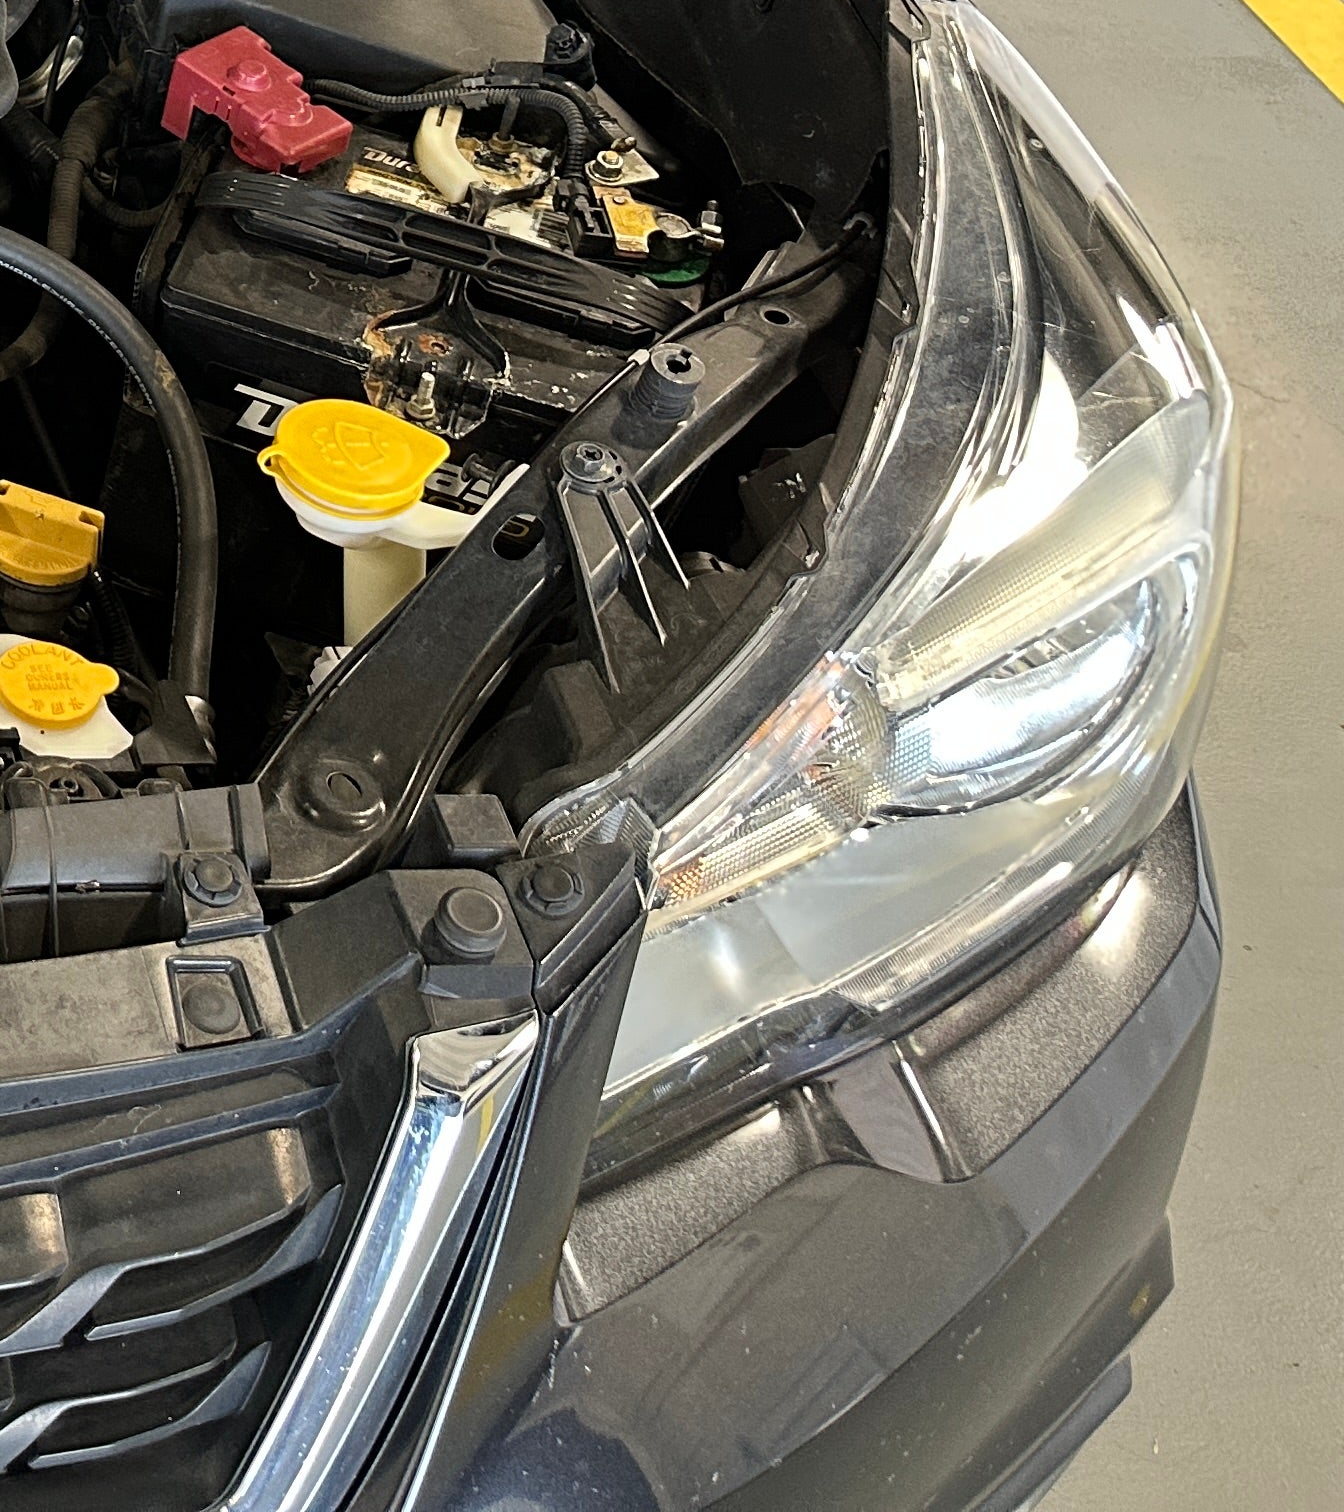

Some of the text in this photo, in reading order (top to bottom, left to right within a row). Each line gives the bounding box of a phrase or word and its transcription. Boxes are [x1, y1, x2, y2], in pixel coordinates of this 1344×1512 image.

[362, 145, 420, 174] Dura
[0, 644, 86, 671] COOLANT
[27, 681, 74, 691] MANUAL
